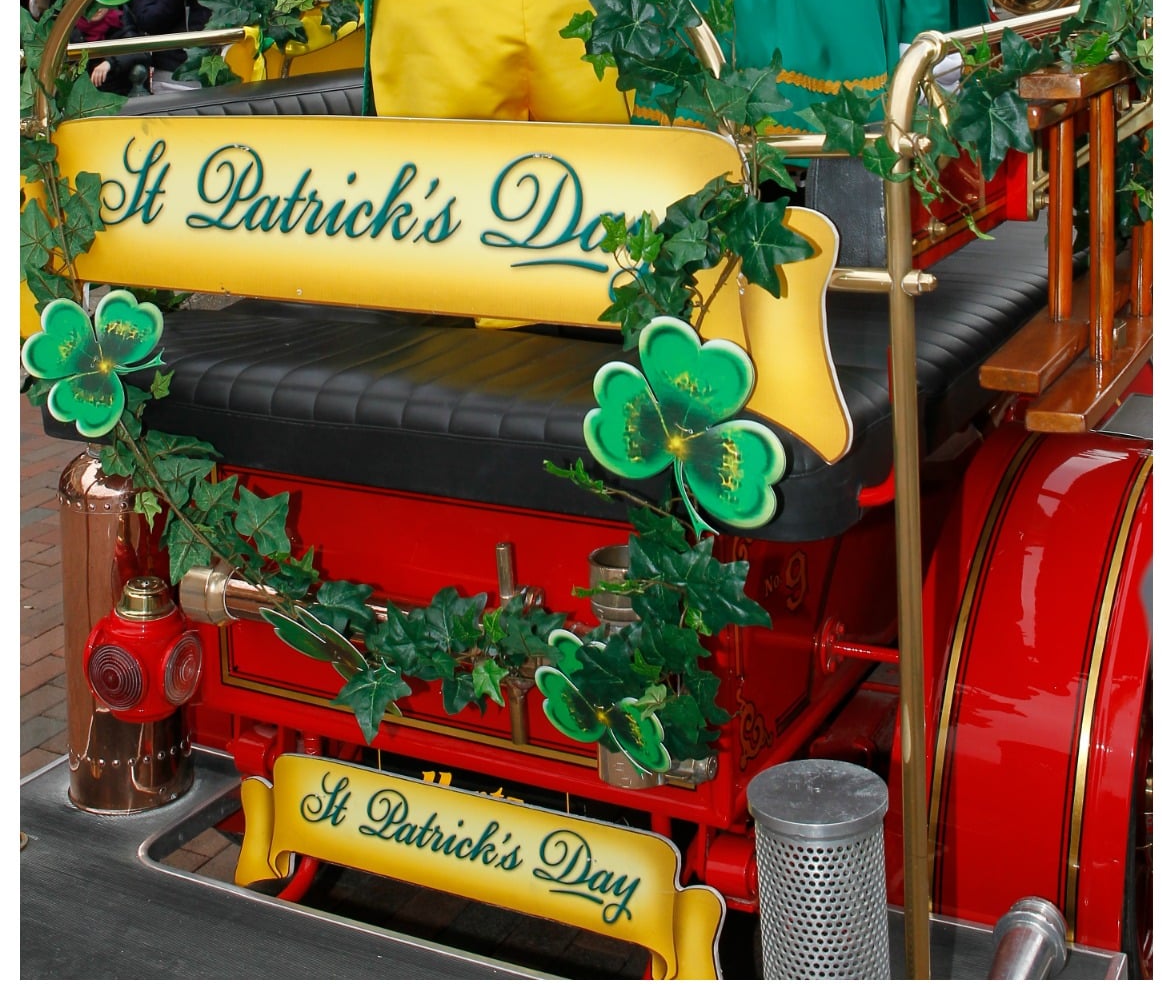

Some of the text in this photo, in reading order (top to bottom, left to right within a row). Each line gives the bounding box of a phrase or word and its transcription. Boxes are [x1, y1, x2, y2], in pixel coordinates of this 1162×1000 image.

[99, 136, 172, 226] St
[186, 143, 462, 244] Patrick's
[785, 550, 807, 611] 9
[299, 771, 351, 826] St
[358, 788, 523, 871] Patrick's
[532, 829, 641, 924] Day
